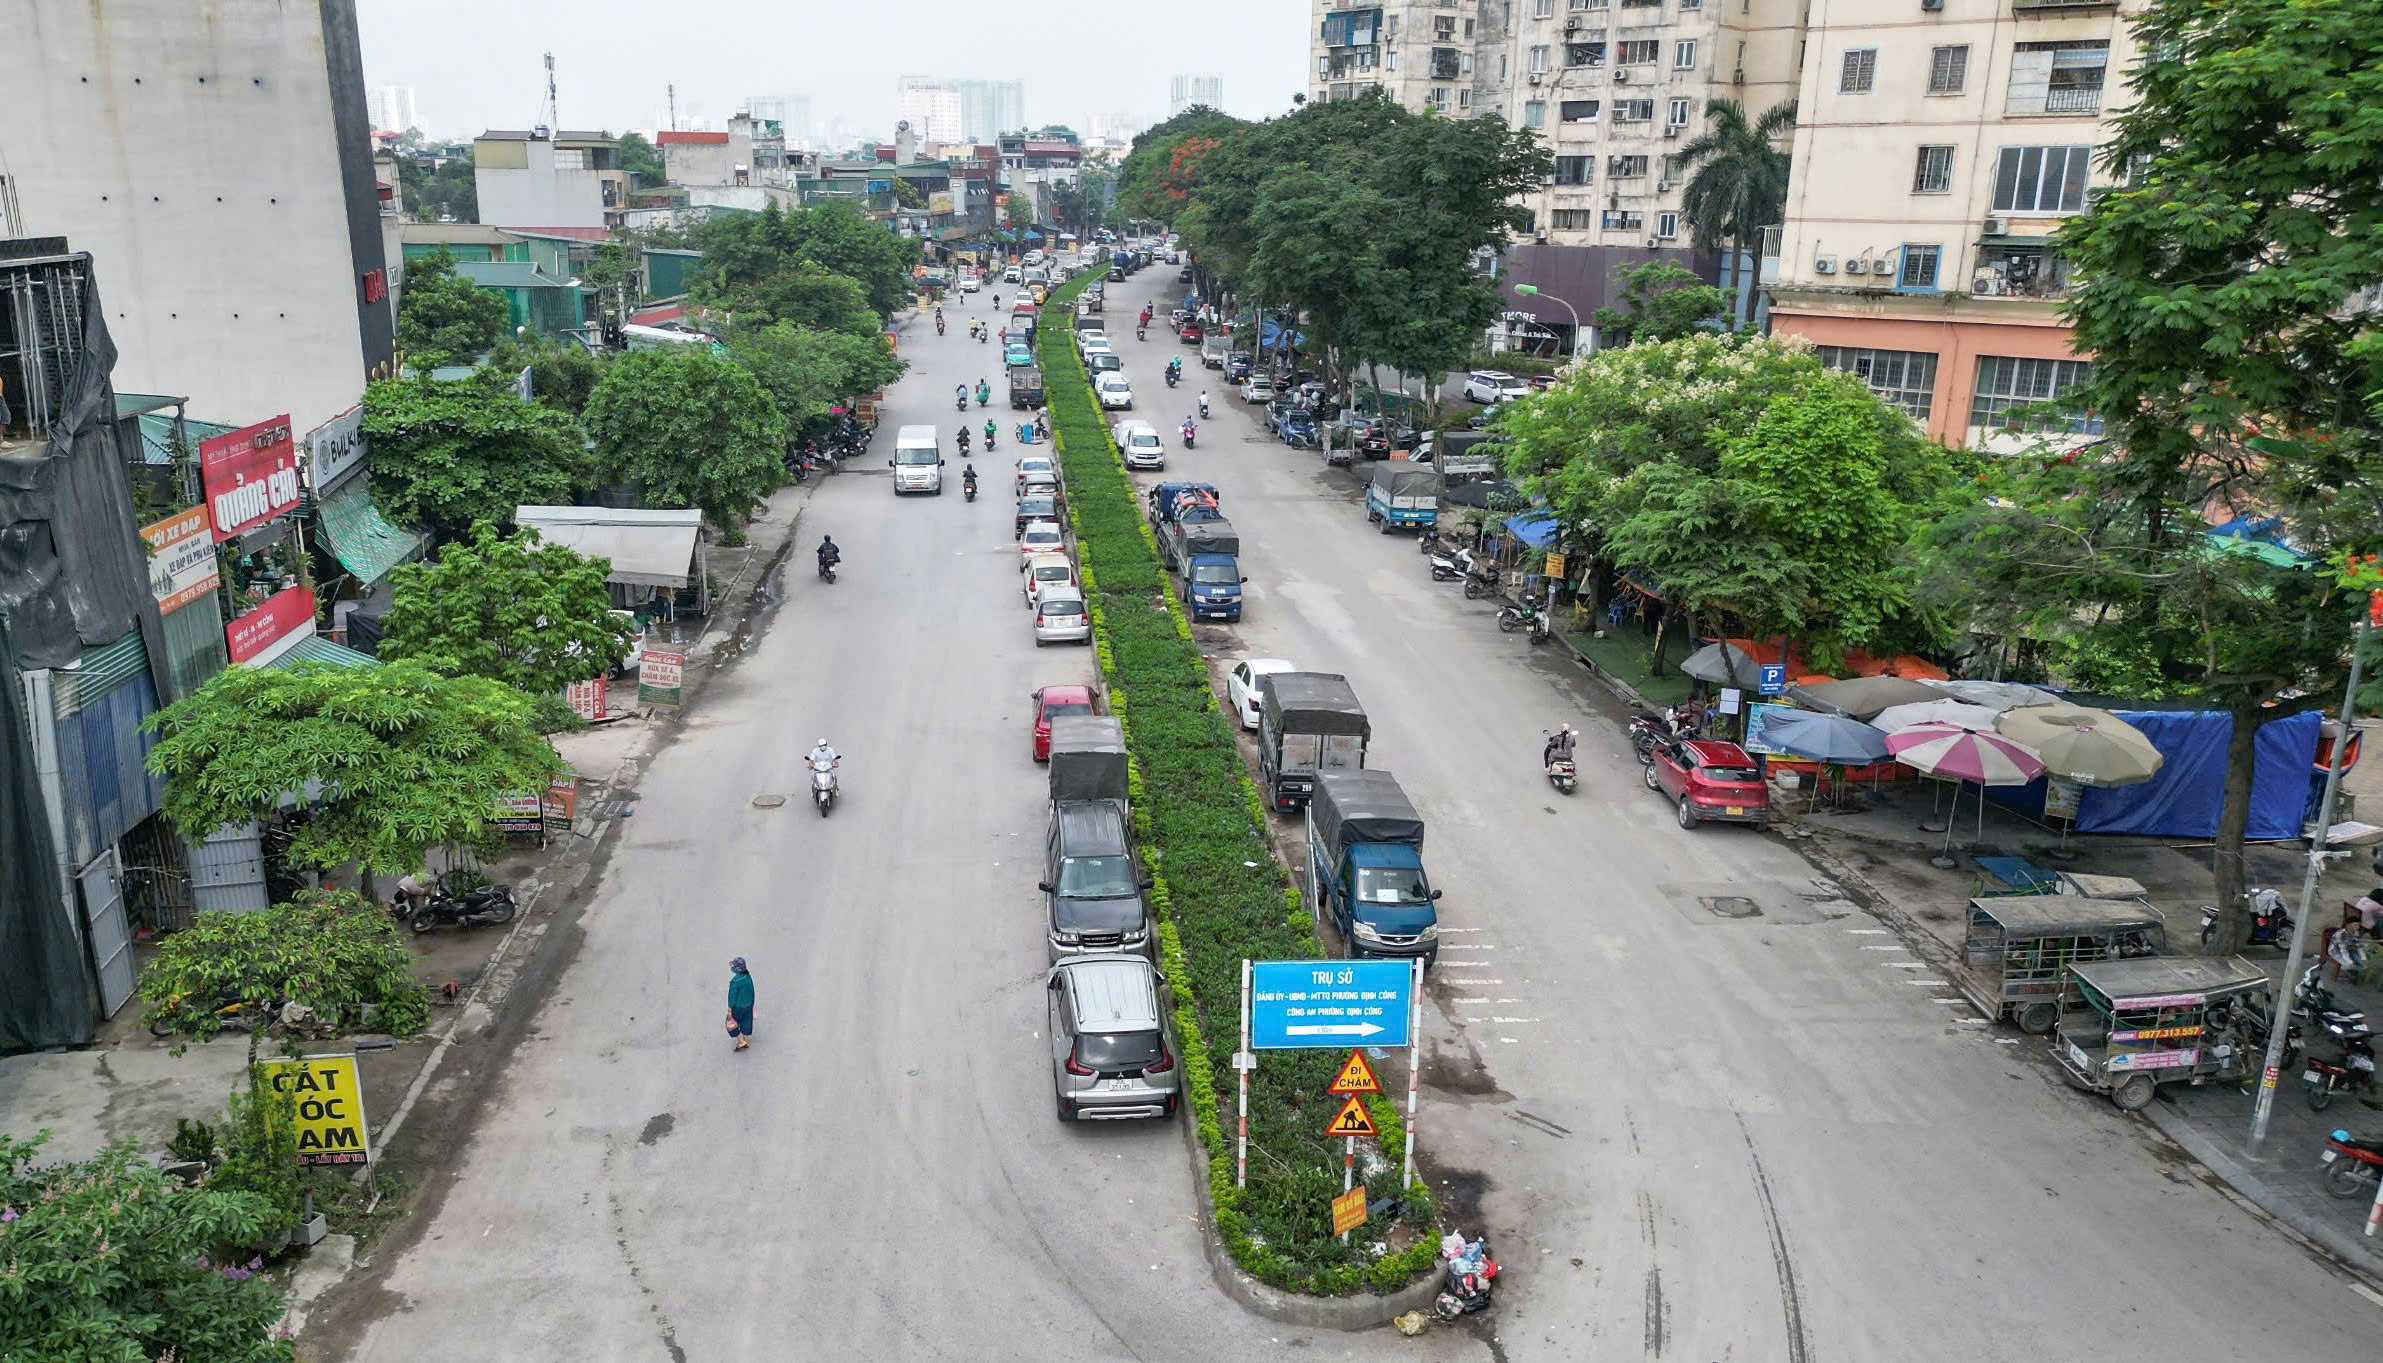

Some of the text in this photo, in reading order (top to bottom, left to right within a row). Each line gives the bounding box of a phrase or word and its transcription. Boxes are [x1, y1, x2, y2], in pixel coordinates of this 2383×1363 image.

[214, 472, 269, 533] QUẢNG
[268, 457, 298, 509] CÁO
[166, 523, 180, 541] XE
[1767, 669, 1778, 682] P
[1312, 967, 1353, 987] TRỤ SỞ
[2138, 1027, 2200, 1038] 0977.313.557
[272, 1063, 339, 1093] CẮT
[1351, 1066, 1361, 1074] ĐI
[1339, 1076, 1371, 1088] CHẬM
[300, 1095, 345, 1120] ÓC
[298, 1127, 359, 1149] AM
